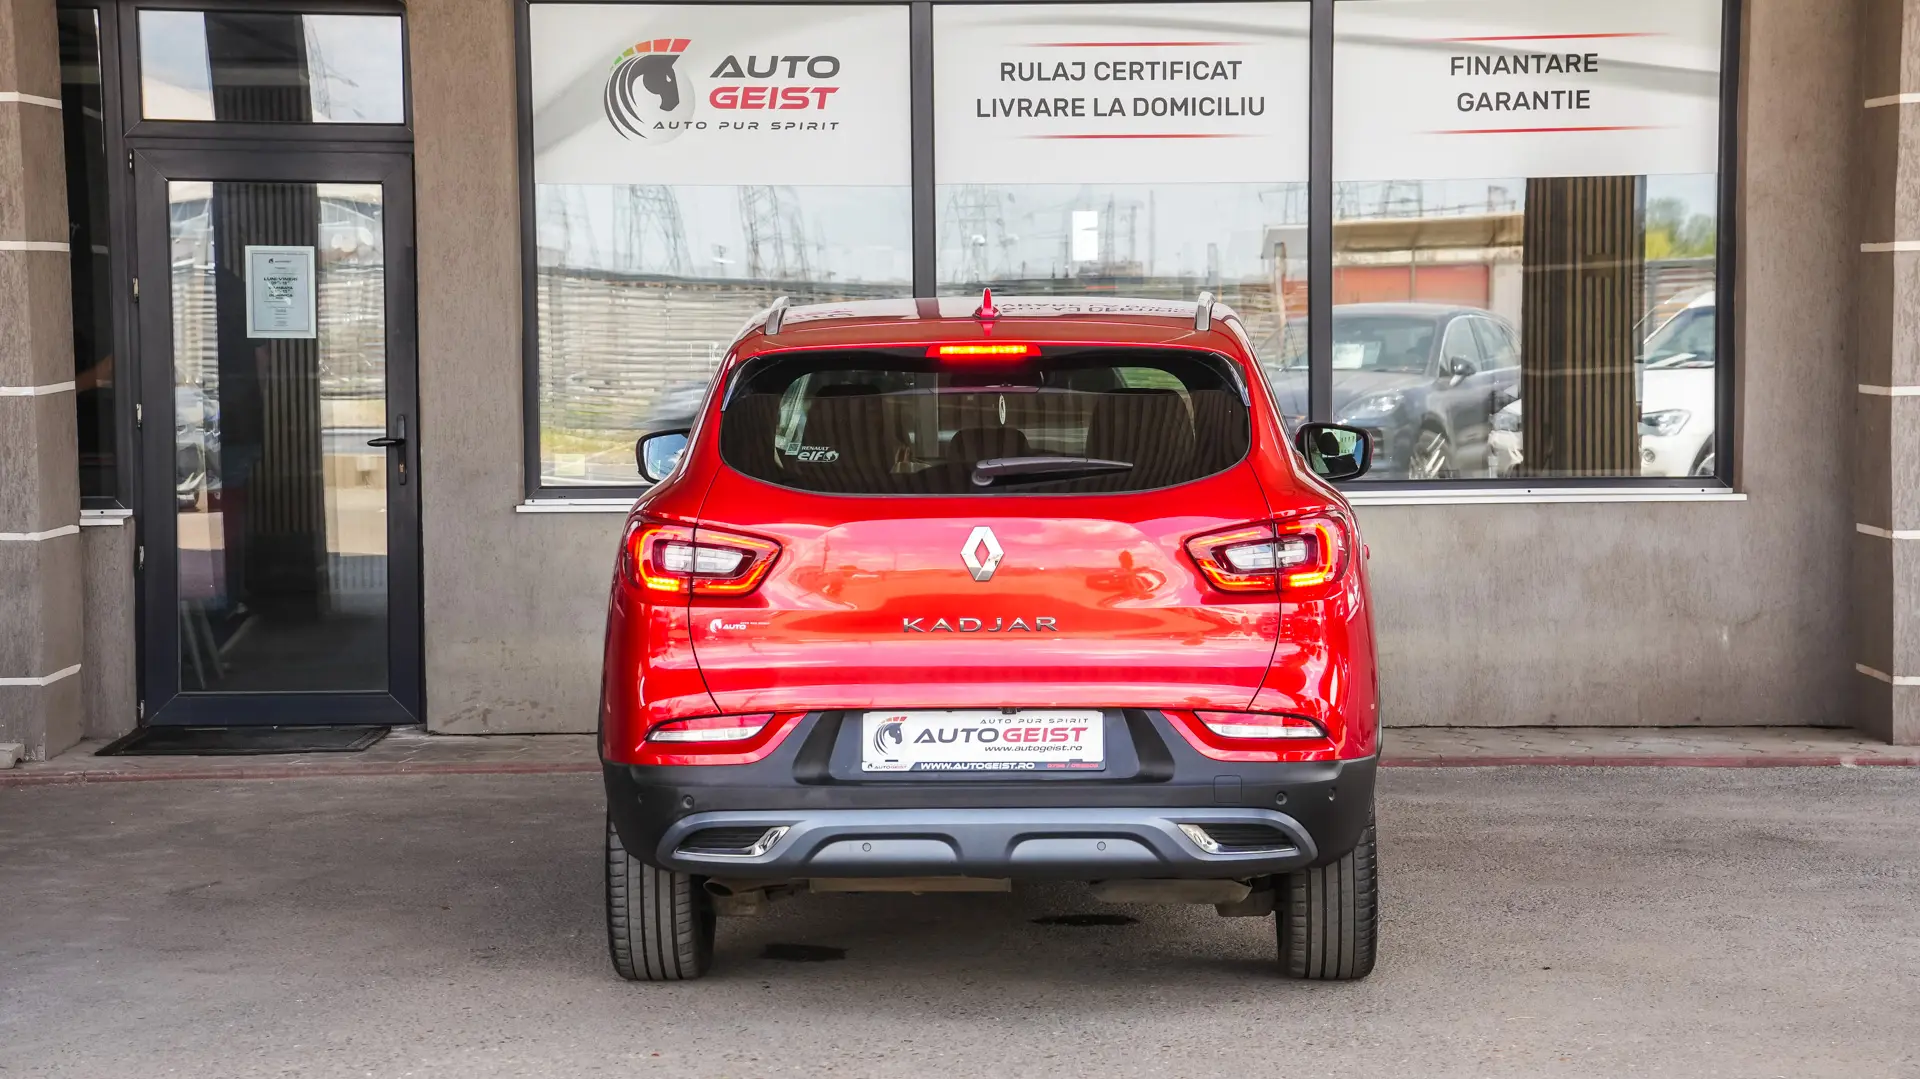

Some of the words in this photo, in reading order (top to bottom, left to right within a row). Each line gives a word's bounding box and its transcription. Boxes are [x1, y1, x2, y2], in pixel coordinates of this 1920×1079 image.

[709, 55, 841, 79] AUTO
[1000, 61, 1086, 82] RULAJ
[1093, 60, 1243, 81] CERTIFICAT
[1450, 53, 1599, 76] FINANTARE
[709, 86, 840, 110] GEIST
[976, 97, 1086, 118] LIVRARE
[1093, 97, 1127, 117] LA
[1133, 96, 1265, 117] DOMICILIU
[1457, 89, 1591, 112] GARANTIE
[652, 121, 708, 130] AUTO
[718, 121, 760, 130] PUR
[770, 121, 840, 131] SPIRIT
[902, 617, 1059, 633] KADJAR
[984, 745, 1083, 754] www.autogeist.ro
[920, 762, 1036, 770] WWW.AUTOGEIST.RO
